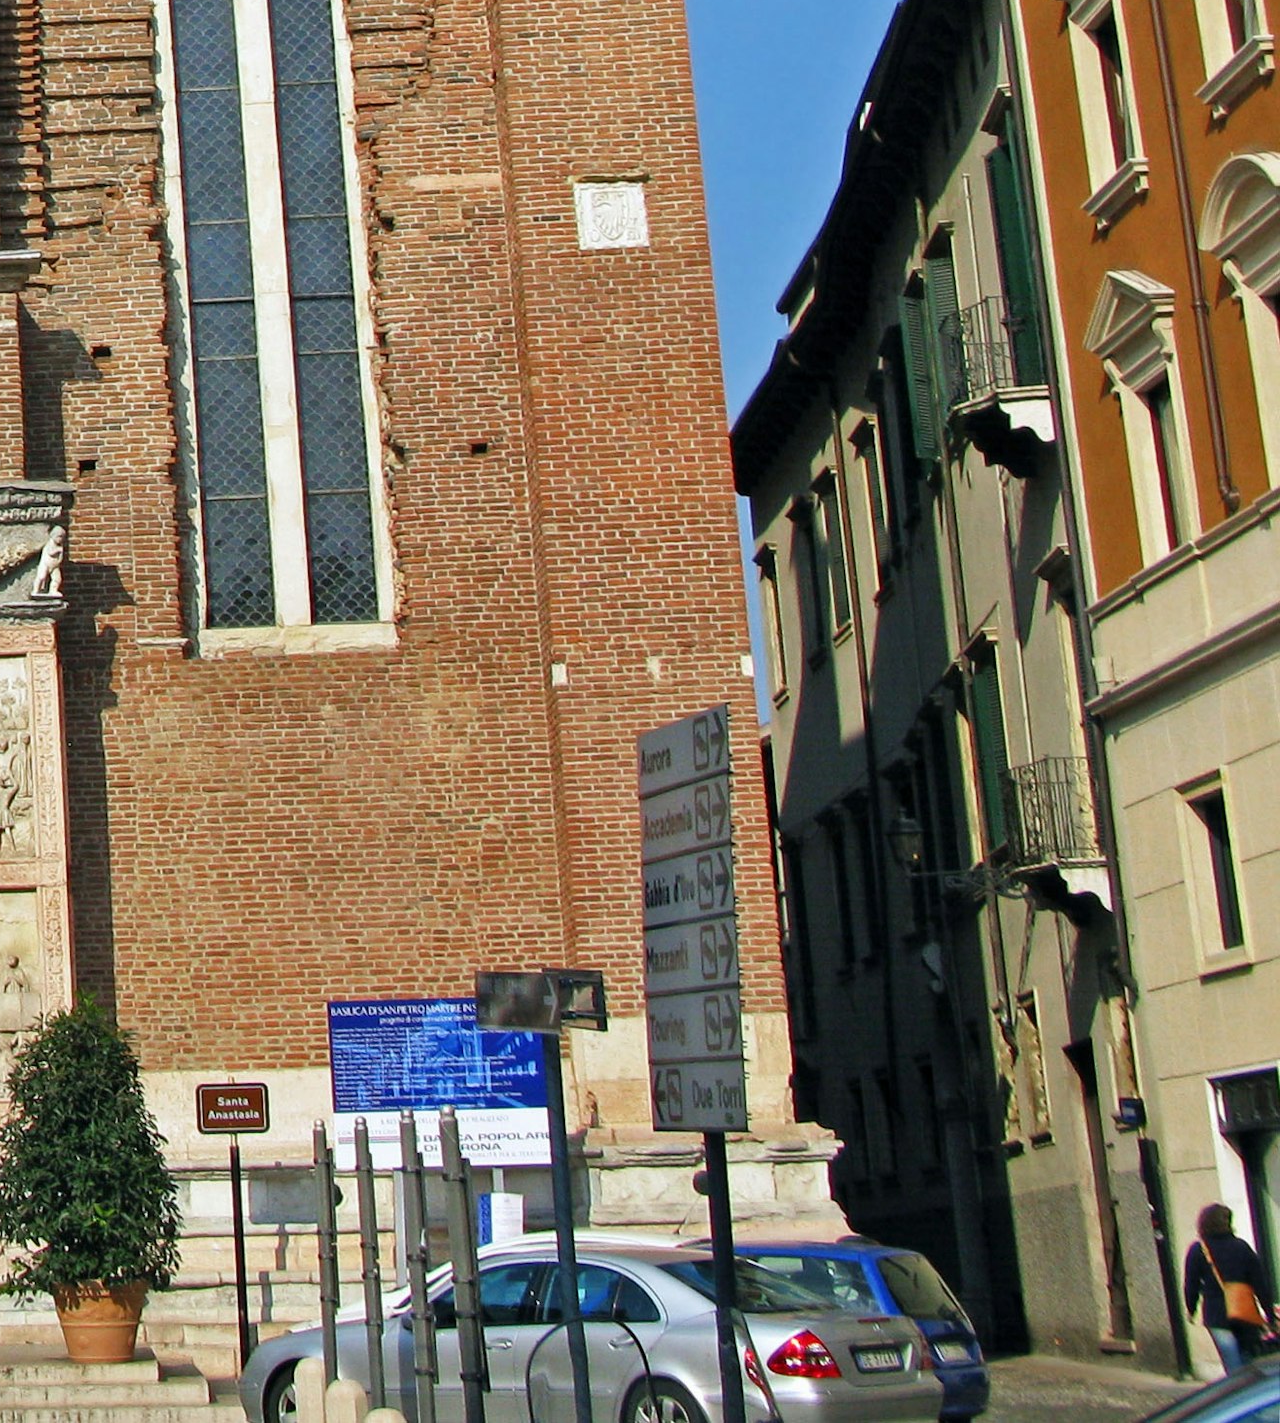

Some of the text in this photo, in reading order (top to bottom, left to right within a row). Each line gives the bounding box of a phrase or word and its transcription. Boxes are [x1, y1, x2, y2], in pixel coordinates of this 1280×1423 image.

[641, 747, 671, 775] Aurora
[644, 805, 693, 842] Accademia
[645, 877, 671, 909] Gabbia
[646, 940, 689, 974] Mazzanti
[330, 1005, 367, 1017] BASILICA
[368, 1005, 378, 1015] DI
[378, 1004, 397, 1015] SAN
[397, 1003, 426, 1016] PIETRO
[426, 1003, 462, 1014] MARTIRE
[649, 1012, 686, 1047] Touring
[217, 1096, 249, 1107] Santa
[692, 1079, 743, 1110] Due Torri
[208, 1109, 260, 1120] Anastasia
